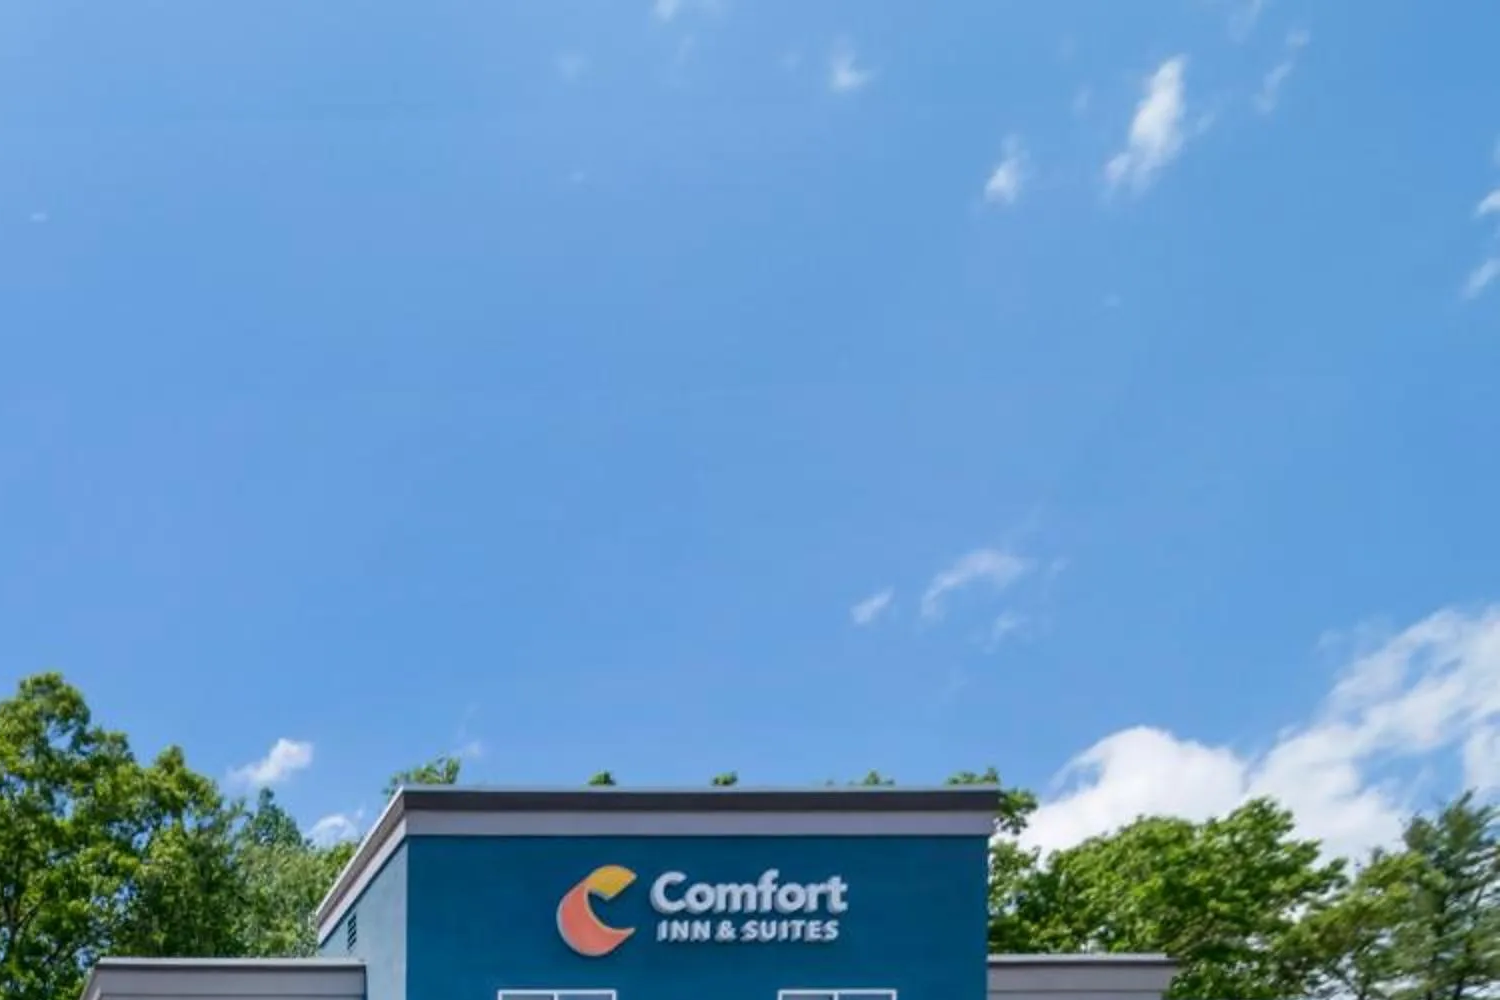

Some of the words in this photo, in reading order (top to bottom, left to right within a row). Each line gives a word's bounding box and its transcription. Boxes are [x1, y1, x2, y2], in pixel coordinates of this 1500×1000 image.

[651, 869, 849, 914] Comfort
[656, 919, 711, 941] INN
[715, 919, 736, 941] &
[740, 919, 840, 941] SUITES
